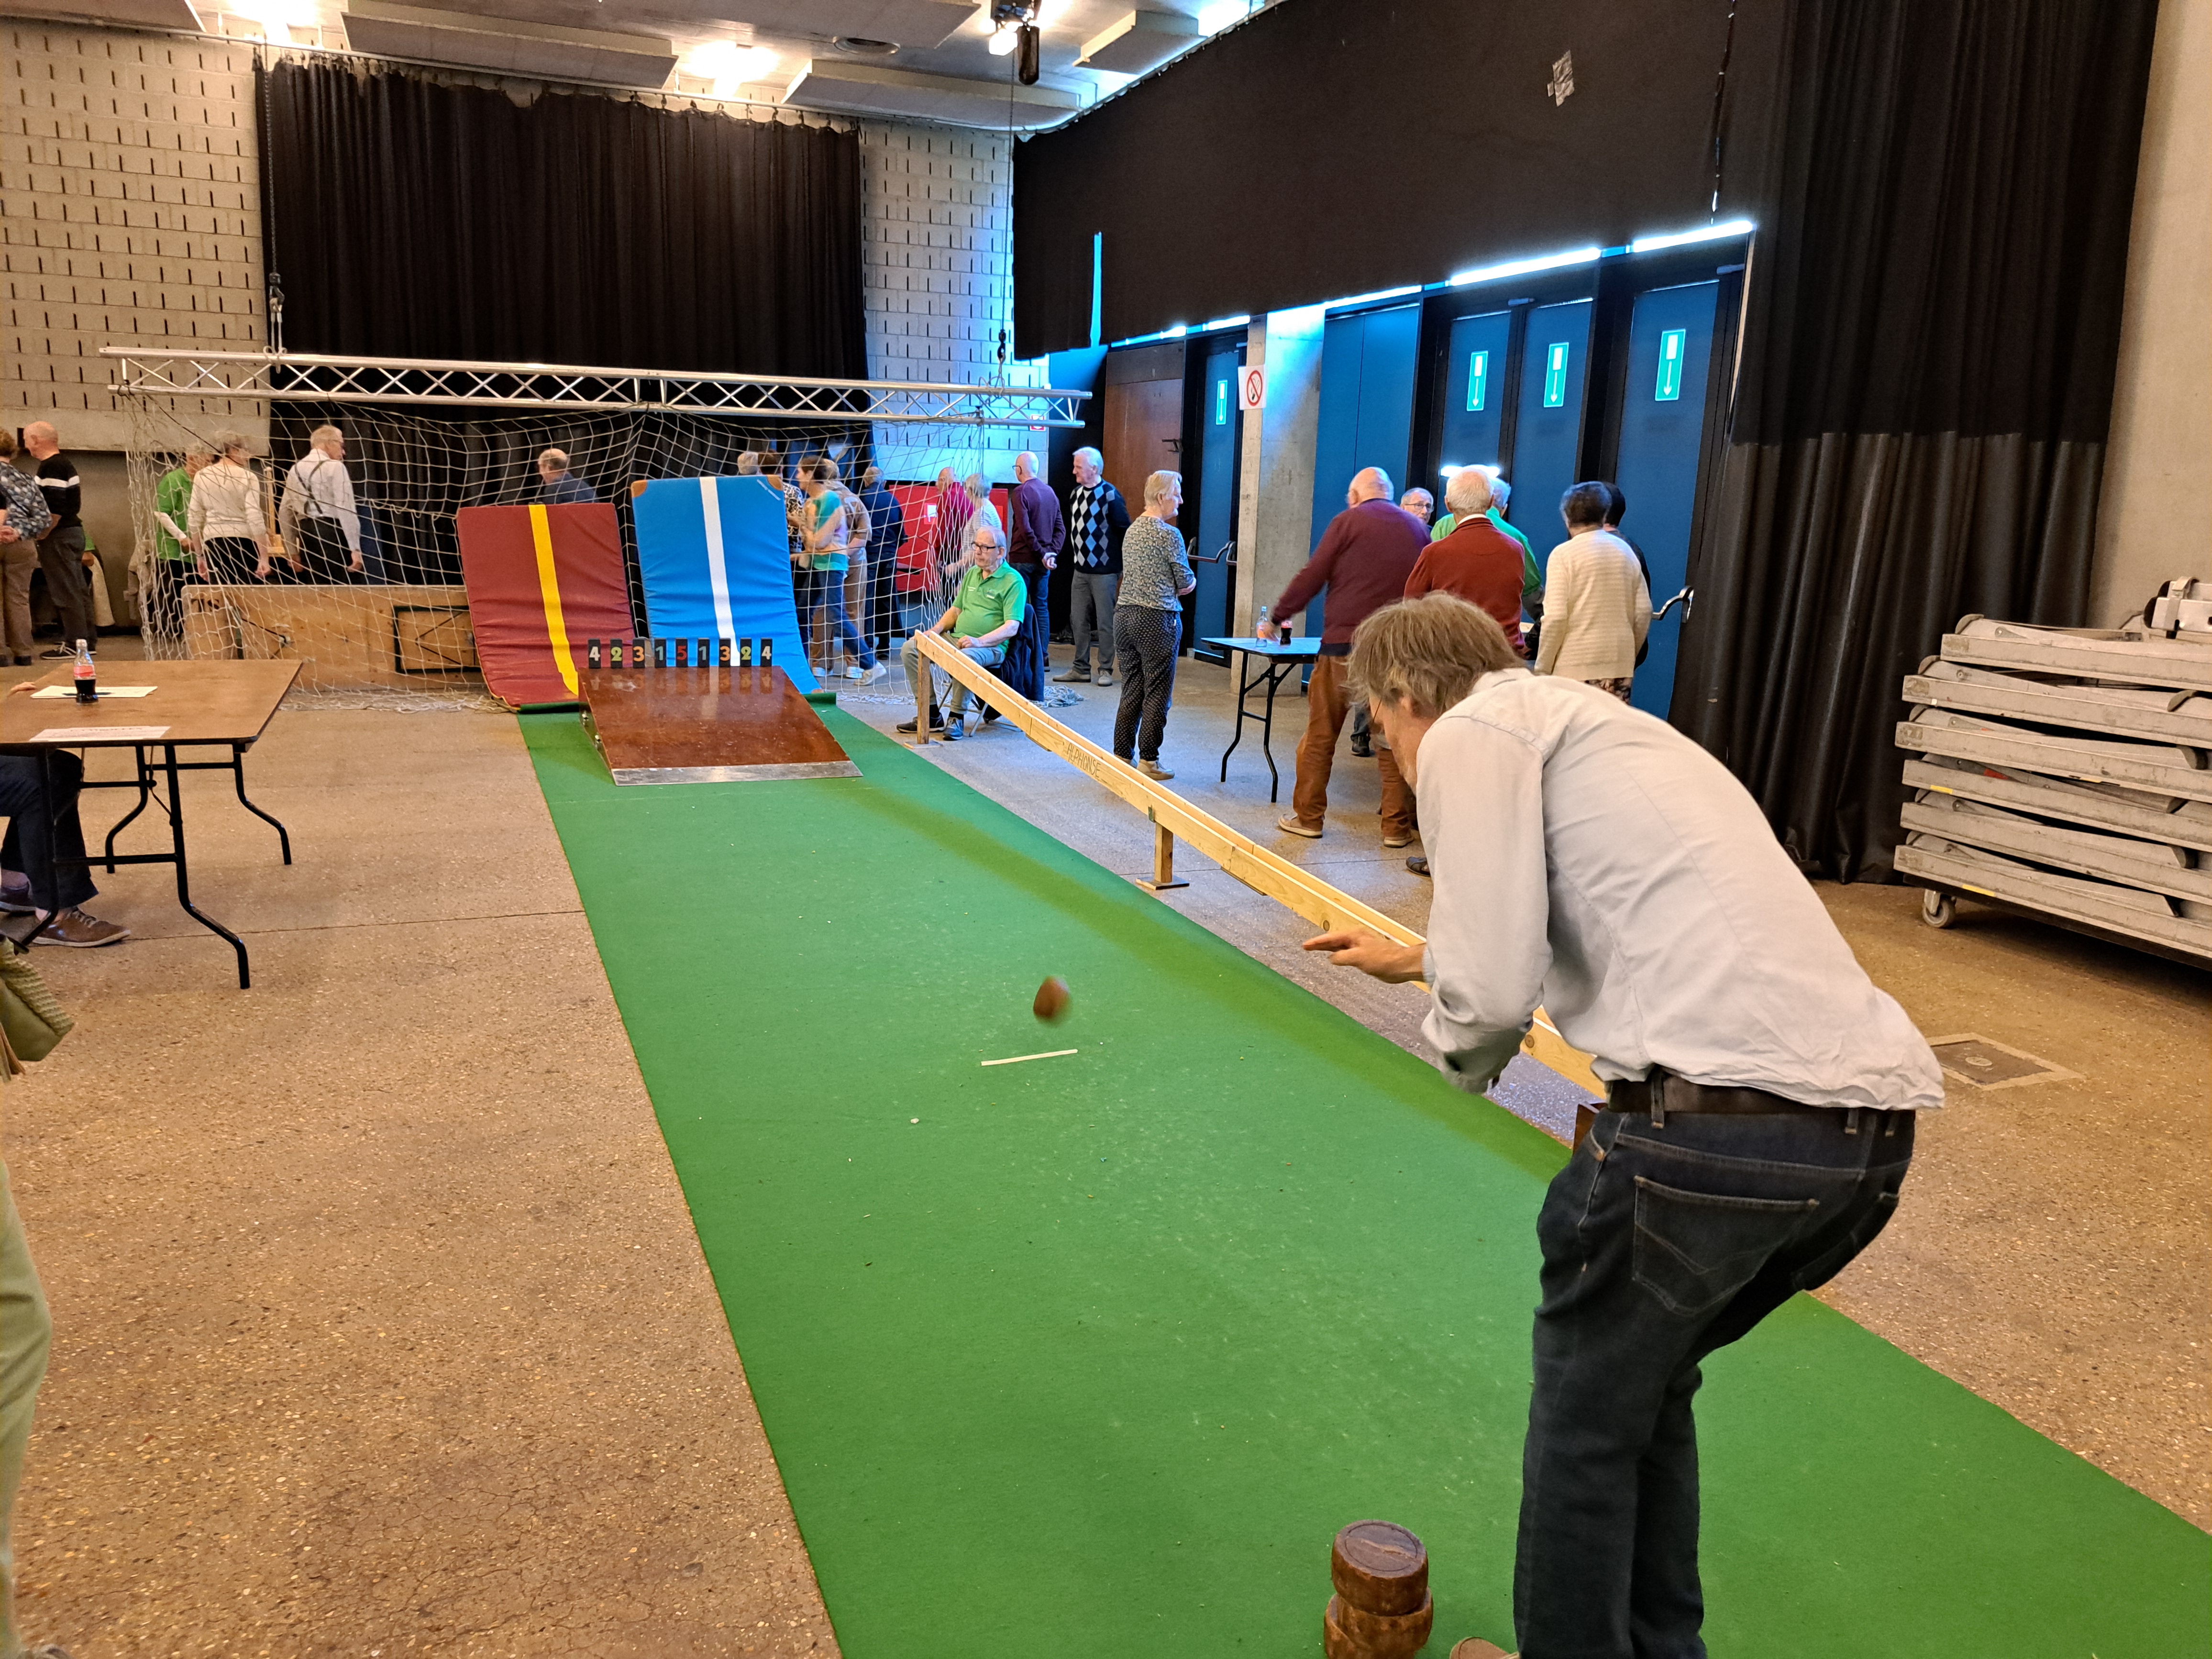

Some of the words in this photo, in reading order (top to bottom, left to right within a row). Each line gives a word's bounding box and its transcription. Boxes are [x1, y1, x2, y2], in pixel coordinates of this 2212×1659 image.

[589, 646, 600, 662] 4
[611, 646, 622, 662] 2
[633, 646, 644, 662] 3
[655, 646, 664, 661] 1
[677, 645, 687, 660] 5
[698, 646, 707, 661] 1
[719, 646, 730, 661] 3
[741, 646, 752, 660] 2
[761, 646, 772, 660] 4
[1066, 742, 1101, 778] ALPHONSE
